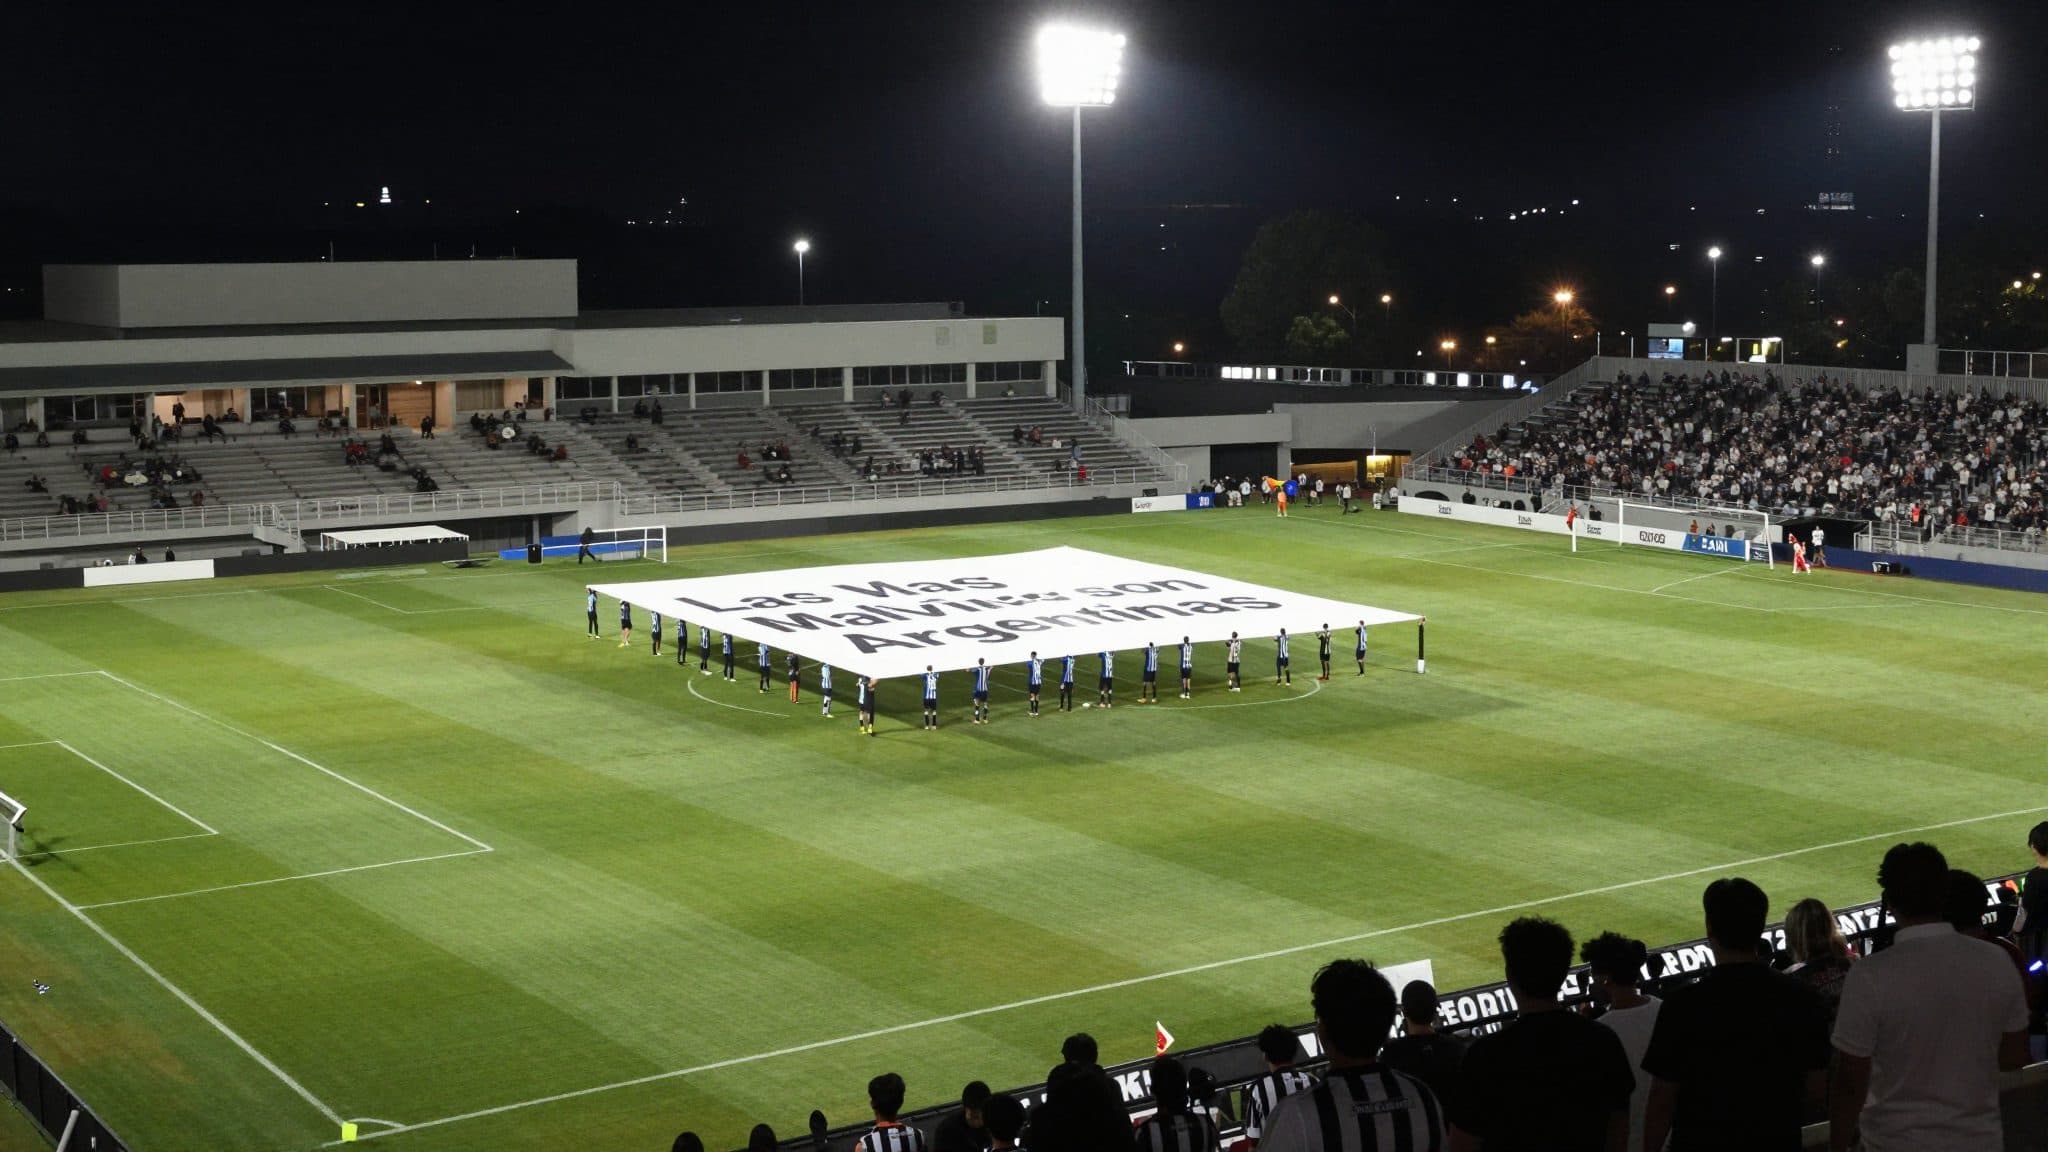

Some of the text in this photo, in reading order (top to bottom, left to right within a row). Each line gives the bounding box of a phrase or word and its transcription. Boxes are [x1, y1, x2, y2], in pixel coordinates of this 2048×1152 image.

[1074, 579, 1209, 597] son
[674, 592, 834, 613] Las
[842, 597, 1282, 654] Argentinas
